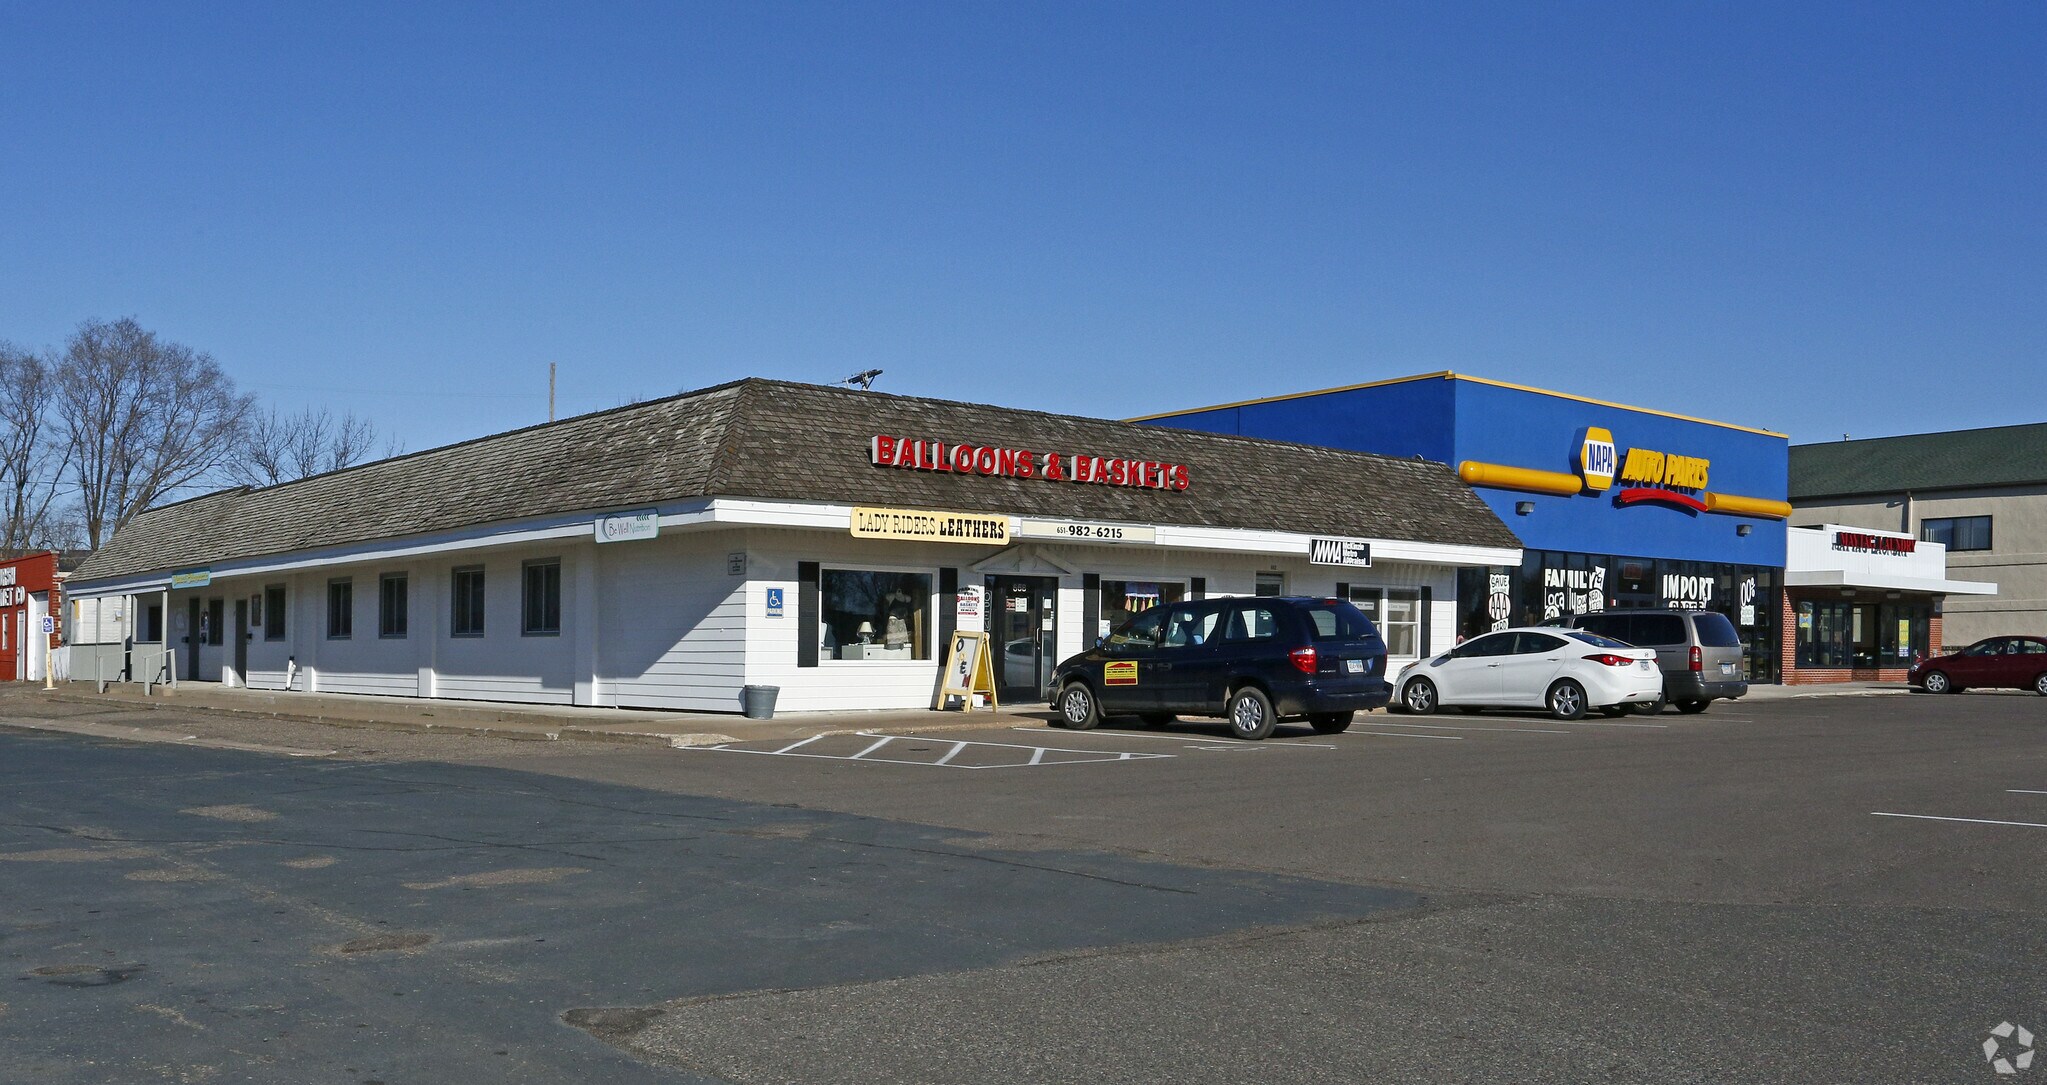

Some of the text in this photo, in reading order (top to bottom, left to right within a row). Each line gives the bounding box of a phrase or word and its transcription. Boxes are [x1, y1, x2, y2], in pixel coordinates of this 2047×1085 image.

[872, 435, 1189, 490] BALLOONS & BASKETS
[1588, 443, 1613, 474] NAPA
[1621, 447, 1710, 490] AUTO PARTS
[609, 523, 617, 536] Be
[618, 522, 629, 535] Well
[859, 512, 1004, 539] LADY RIDERS LEATHERS
[1312, 540, 1341, 563] MMA
[1491, 576, 1508, 588] SAVE
[1544, 568, 1596, 589] FAMILY
[1663, 574, 1714, 602] IMPORT
[1490, 593, 1508, 619] AAA
